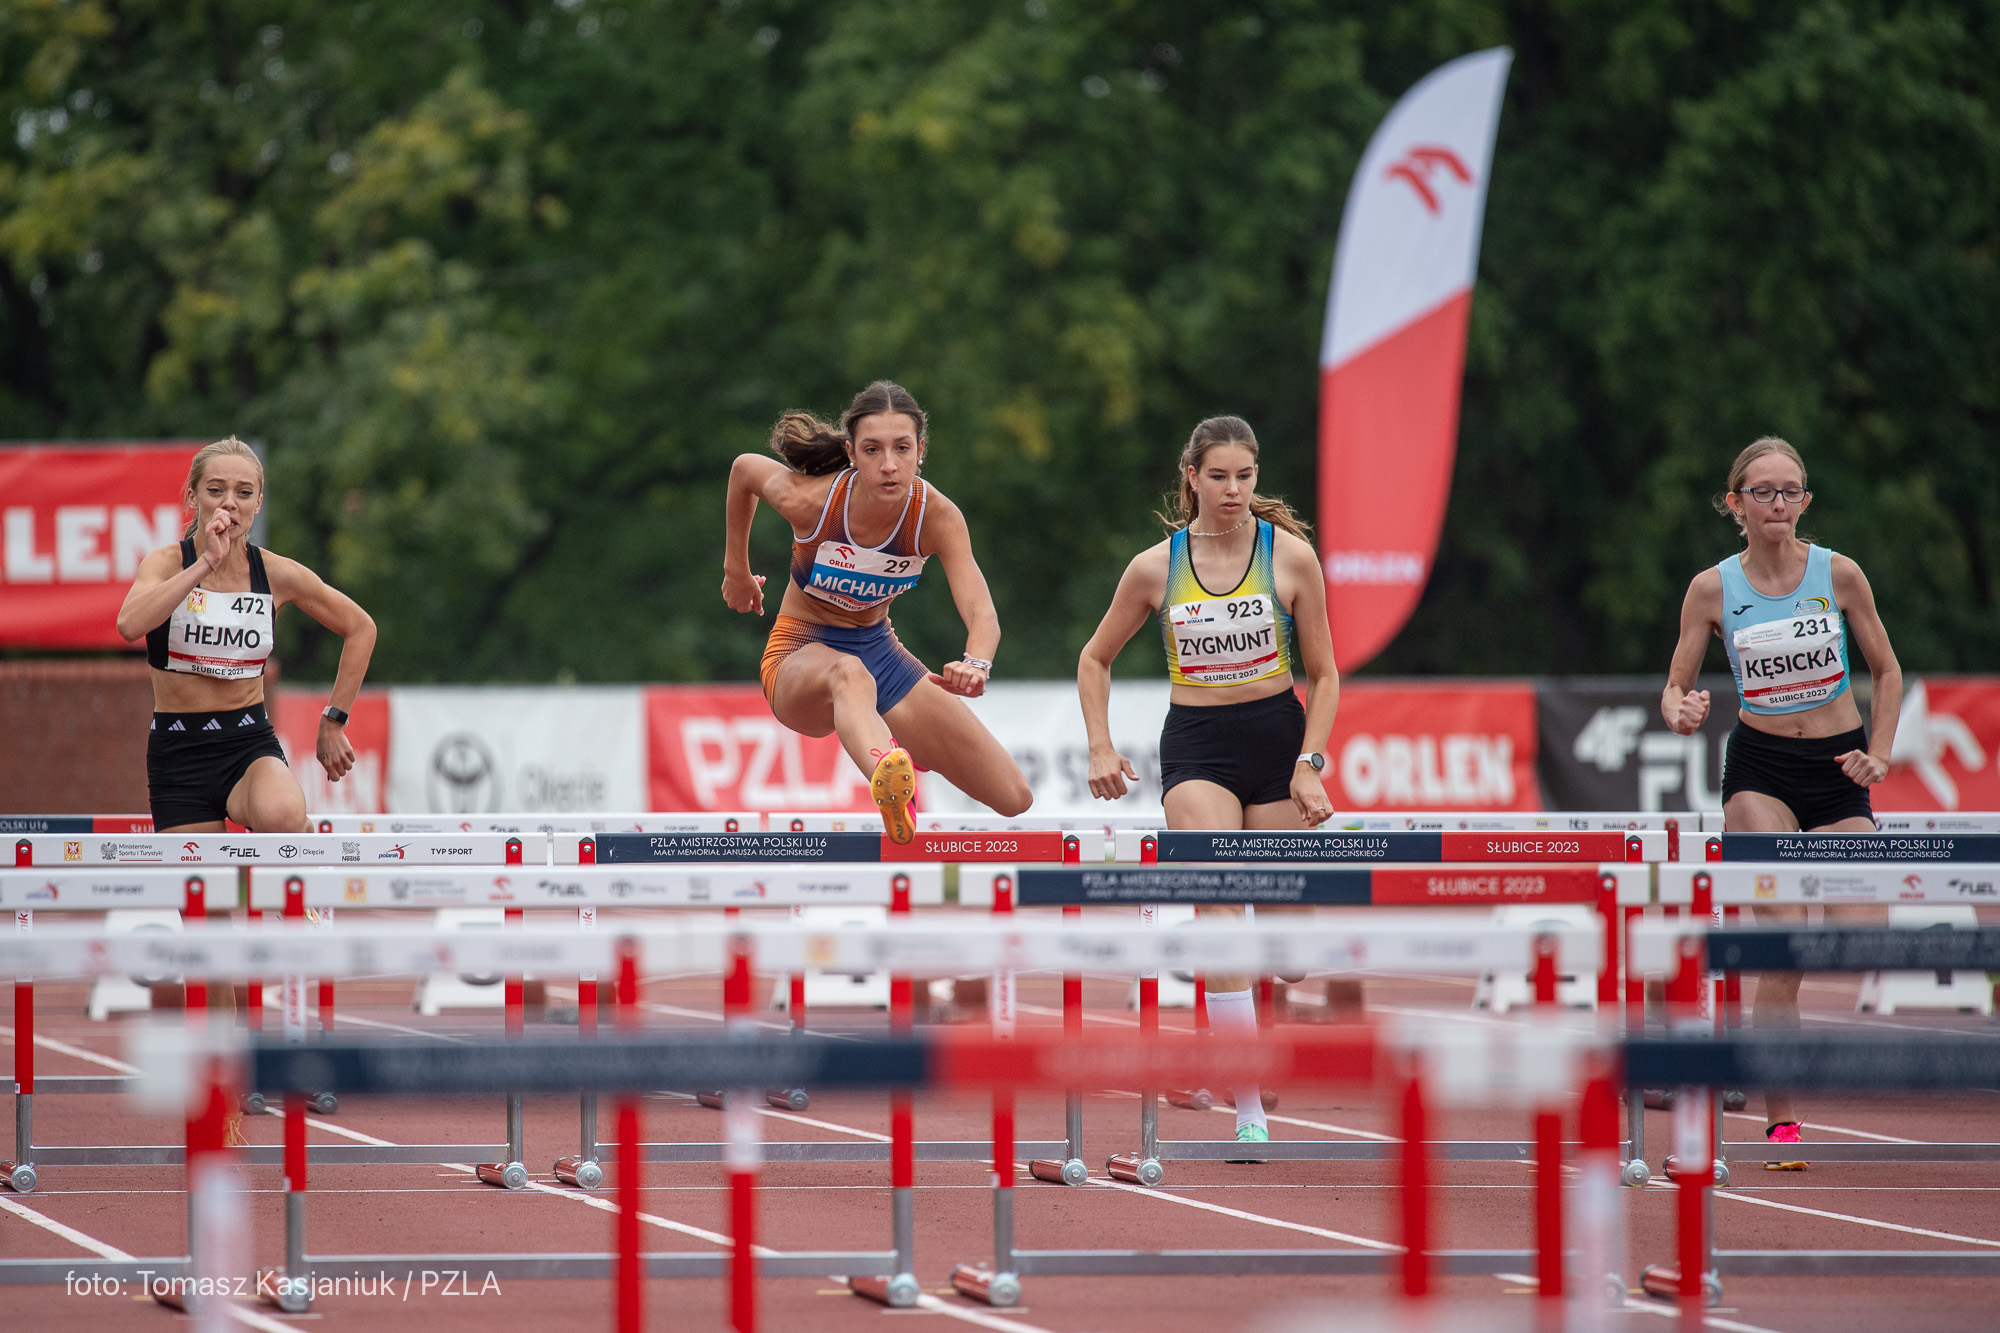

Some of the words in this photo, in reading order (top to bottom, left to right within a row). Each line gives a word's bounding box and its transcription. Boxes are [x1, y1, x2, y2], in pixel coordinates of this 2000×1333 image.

[0, 505, 183, 584] LEN
[829, 559, 855, 570] ORLEN
[883, 559, 911, 574] 29
[231, 597, 264, 615] 472
[1227, 599, 1264, 620] 923
[1793, 617, 1831, 638] 231
[184, 624, 261, 649] HEJMO
[1179, 628, 1271, 656] ZYGMUNT
[1745, 646, 1838, 680] KĘSICKA
[191, 664, 226, 676] SŁUBICE
[227, 668, 244, 676] 2023
[1203, 673, 1237, 682] SŁUBICE
[1239, 668, 1258, 679] 2023
[1769, 692, 1805, 704] SŁUBICE
[1806, 688, 1827, 698] 2023
[1340, 733, 1516, 808] ORLEN
[650, 837, 678, 847] PZLA
[680, 837, 760, 847] MISTRZOSTWA
[764, 837, 802, 847] POLSKI
[806, 837, 827, 847] U16
[925, 841, 981, 853] SŁUBICE
[985, 841, 1018, 853] 2023
[1212, 838, 1239, 848] PZLA
[1242, 838, 1321, 848] MISTRZOSTWA
[1324, 838, 1363, 848] POLSKI
[1366, 838, 1388, 848] U16
[1486, 841, 1543, 853] SŁUBICE
[1547, 841, 1579, 853] 2023
[1776, 839, 1804, 849] PZLA
[1807, 839, 1887, 849] MISTRZOSTWA
[1890, 839, 1929, 849] POLSKI
[1933, 839, 1954, 849] U16
[302, 848, 325, 856] Okęcie
[378, 851, 399, 859] polanik
[759, 847, 823, 856] KUSOCIŃSKIEGO
[1320, 848, 1385, 857] KUSOCIŃSKIEGO
[1886, 849, 1951, 858] KUSOCIŃSKIEGO
